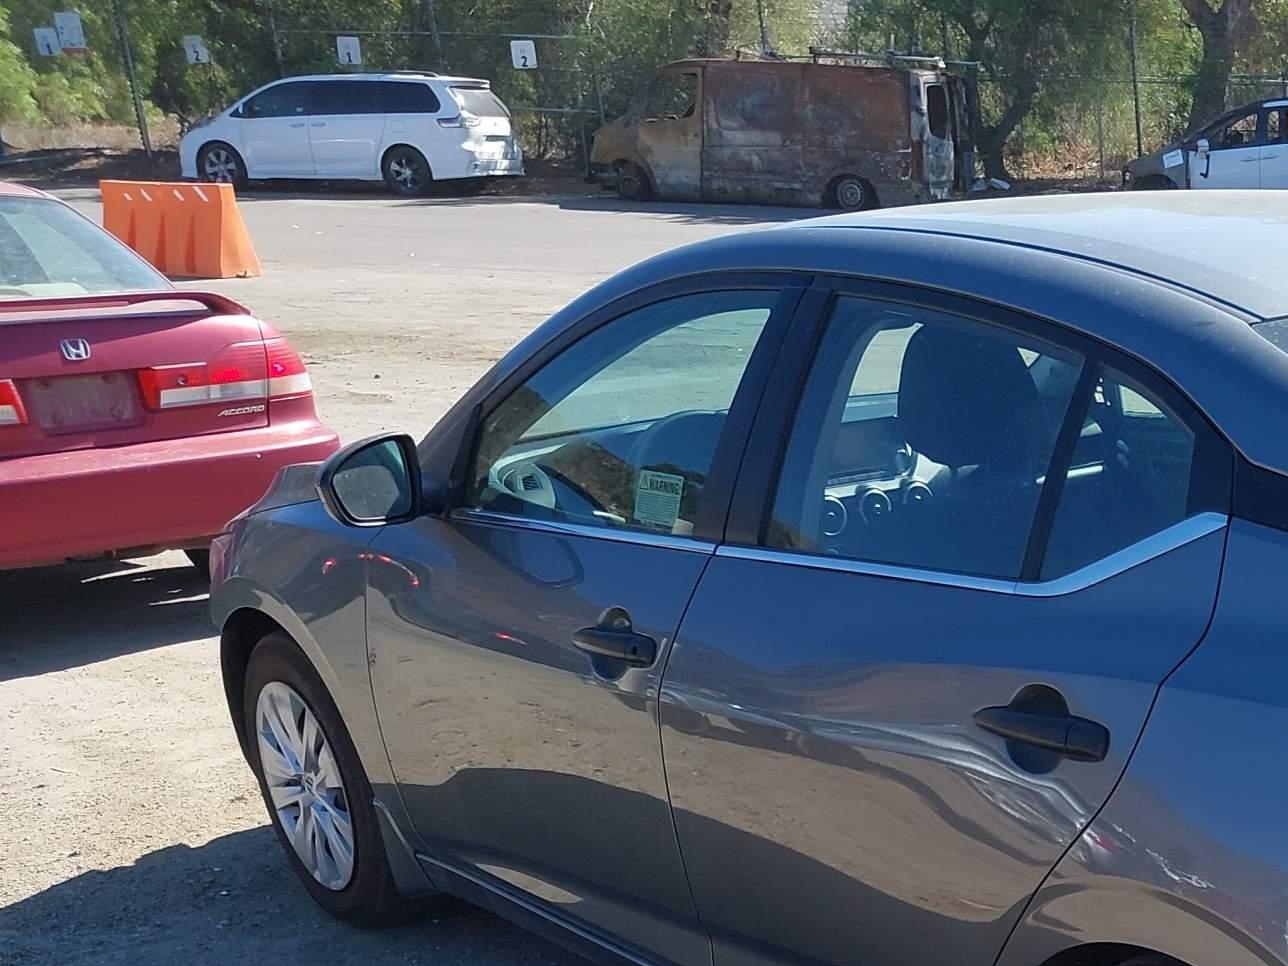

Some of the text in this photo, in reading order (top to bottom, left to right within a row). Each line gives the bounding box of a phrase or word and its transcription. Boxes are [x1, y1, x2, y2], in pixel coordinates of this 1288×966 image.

[193, 50, 202, 62] 2
[521, 56, 529, 67] 2
[217, 404, 265, 417] ACCORD
